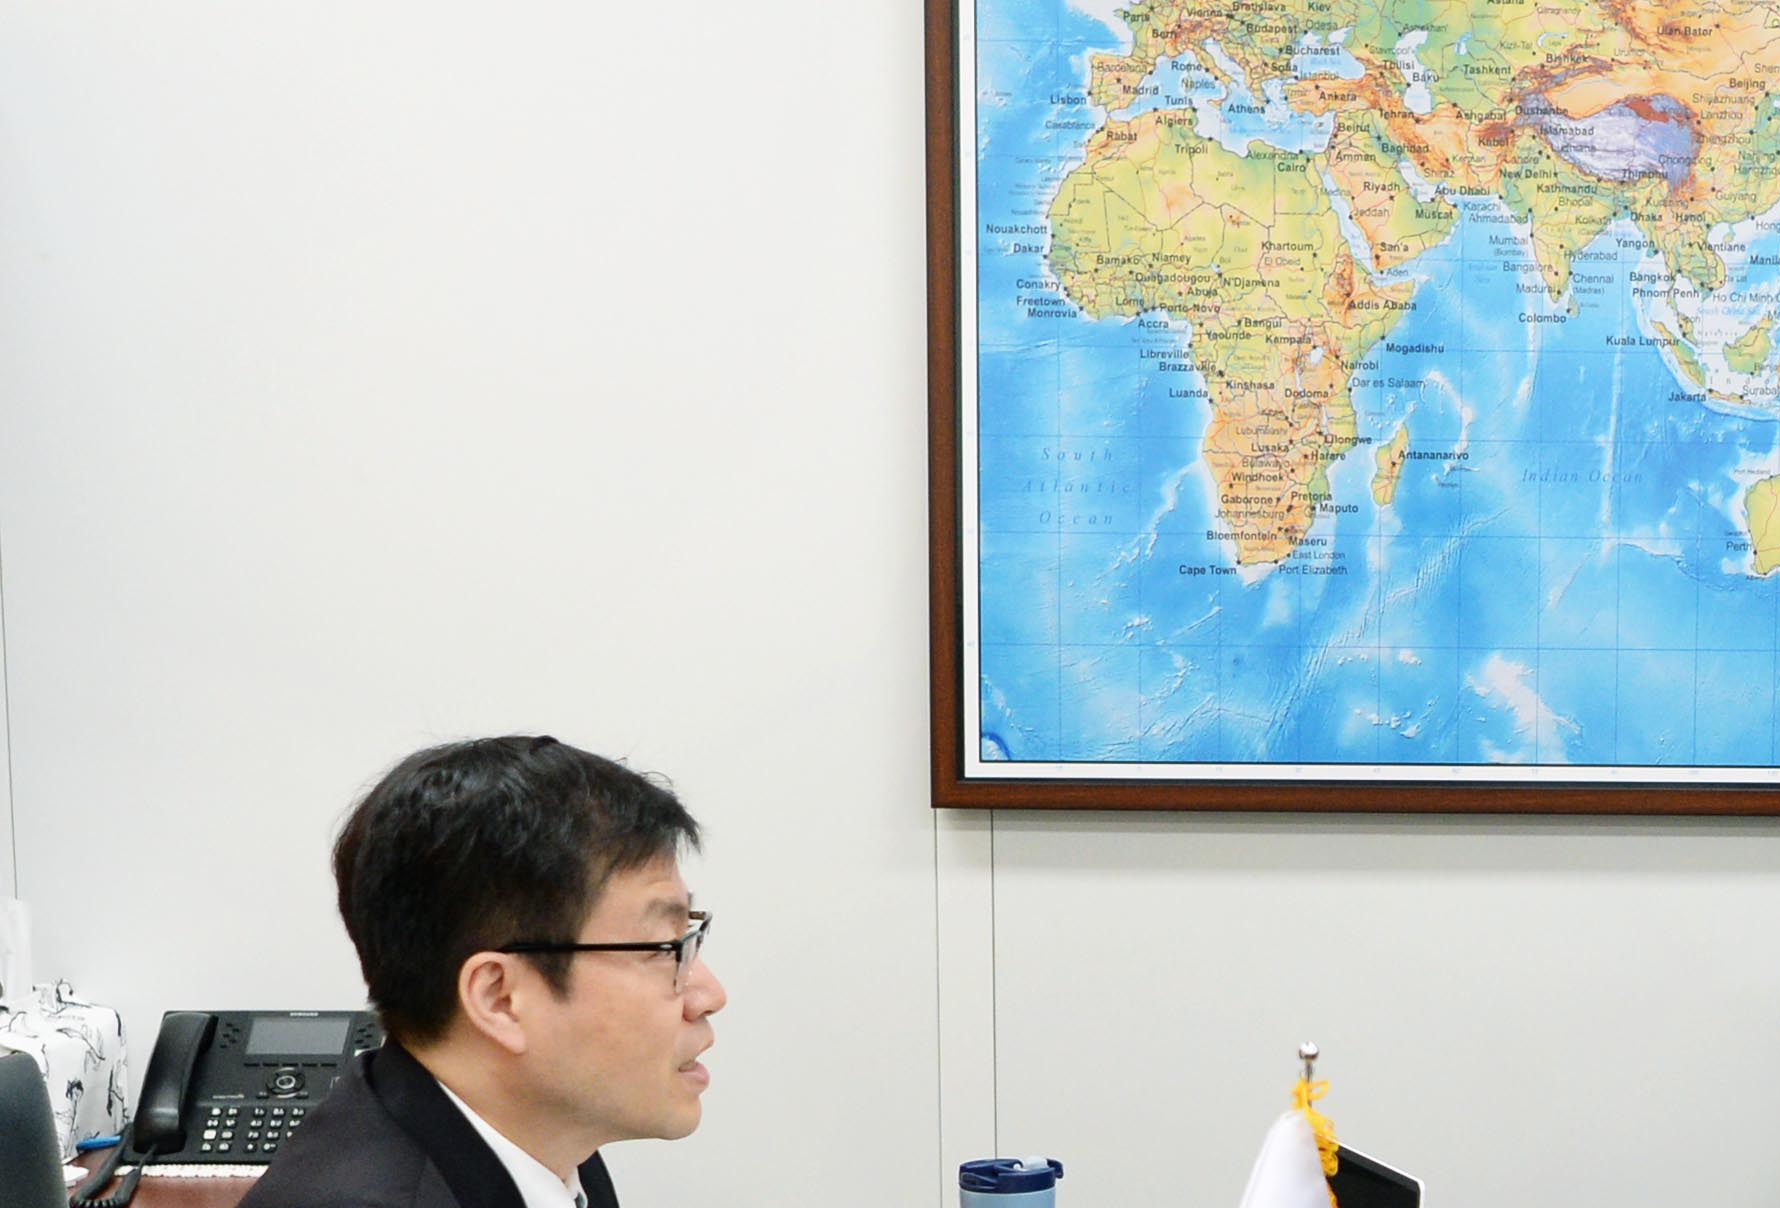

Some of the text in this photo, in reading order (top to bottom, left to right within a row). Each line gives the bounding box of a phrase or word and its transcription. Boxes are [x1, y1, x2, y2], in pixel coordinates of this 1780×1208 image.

[1308, 2, 1332, 12] Kiev
[1247, 23, 1298, 35] Budapest
[1286, 46, 1340, 56] Bucharest
[1171, 61, 1202, 72] Rome
[1463, 64, 1511, 75] Tashkent
[1412, 72, 1439, 83] Baku
[1123, 84, 1159, 95] Madrid
[1182, 78, 1216, 90] Naples
[1729, 78, 1766, 91] Beijing
[1050, 95, 1087, 105] Lisbon
[1165, 96, 1193, 106] Tunis
[1319, 91, 1357, 102] Ankara
[1228, 103, 1266, 115] Athens
[1379, 109, 1414, 119] Tehran
[1515, 106, 1568, 116] Dushanbe
[1155, 116, 1193, 128] Algiers
[1338, 122, 1370, 133] Beirut
[1106, 131, 1137, 142] Rabat
[1539, 126, 1594, 136] Islamabad
[1175, 144, 1209, 156] Tripoli
[1382, 143, 1429, 154] Baghdad
[1336, 152, 1376, 162] Amman
[1277, 162, 1306, 173] Cairo
[1501, 169, 1552, 179] New Delhi
[1363, 182, 1400, 193] Riyadh
[1435, 185, 1490, 196] Abu Dhabi
[1537, 184, 1598, 195] Kathmandu
[1463, 202, 1500, 212] Karachi
[1416, 209, 1453, 220] Muscat
[1630, 212, 1663, 223] Dhaka
[1675, 212, 1706, 223] Hanoi
[986, 224, 1047, 235] Nouakchott
[1489, 235, 1528, 246] Mumbai
[1616, 239, 1655, 250] Yangon
[1013, 243, 1044, 254] Dakar
[1261, 241, 1314, 252] Khartoum
[1699, 242, 1746, 252] Vientiane
[1096, 255, 1140, 265] Bamako
[1152, 253, 1192, 265] Niamey
[1564, 251, 1617, 261] Hyderabad
[1503, 261, 1553, 273] Bangalore
[1135, 273, 1211, 285] Ouagadougou
[1572, 274, 1614, 284] Chennai
[1630, 272, 1675, 283] Bangkok
[1016, 279, 1061, 291] Conakry
[1187, 287, 1218, 298] Abuja
[1632, 288, 1700, 298] Phnom Penh
[1016, 296, 1065, 307] Freetown
[1350, 300, 1417, 311] Addis Ababa
[1028, 308, 1077, 319] Monrovia
[1159, 303, 1220, 314] Porto-Novo
[1138, 319, 1169, 329] Accra
[1244, 318, 1282, 329] Bangui
[1518, 313, 1567, 324] Colombo
[1265, 335, 1312, 346] Kampala
[1606, 336, 1680, 348] Kuala Lumpur
[1140, 349, 1190, 360] Libreville
[1386, 343, 1445, 355] Mogadishu
[1158, 362, 1217, 372] Brazzaville
[1340, 360, 1379, 371] Nairobi
[1225, 380, 1275, 391] Kinshasa
[1169, 388, 1208, 398] Luanda
[1284, 387, 1329, 398] Dodoma
[1668, 392, 1707, 402] Jakarta
[1324, 435, 1372, 446] Lilongwe
[1251, 443, 1290, 453] Lusaka
[1399, 451, 1469, 461] Antananarivo
[1231, 472, 1283, 482] Windhoek
[1522, 469, 1643, 483] Indian Ocean
[1221, 495, 1273, 505] Gaborone
[1291, 491, 1332, 501] Pretoria
[1319, 504, 1359, 515] Maputo
[1206, 531, 1277, 541] Bloemfontein
[1289, 537, 1327, 546] Maseru
[1179, 566, 1237, 577] Cape Town
[1279, 565, 1348, 575] Port Elizabeth
